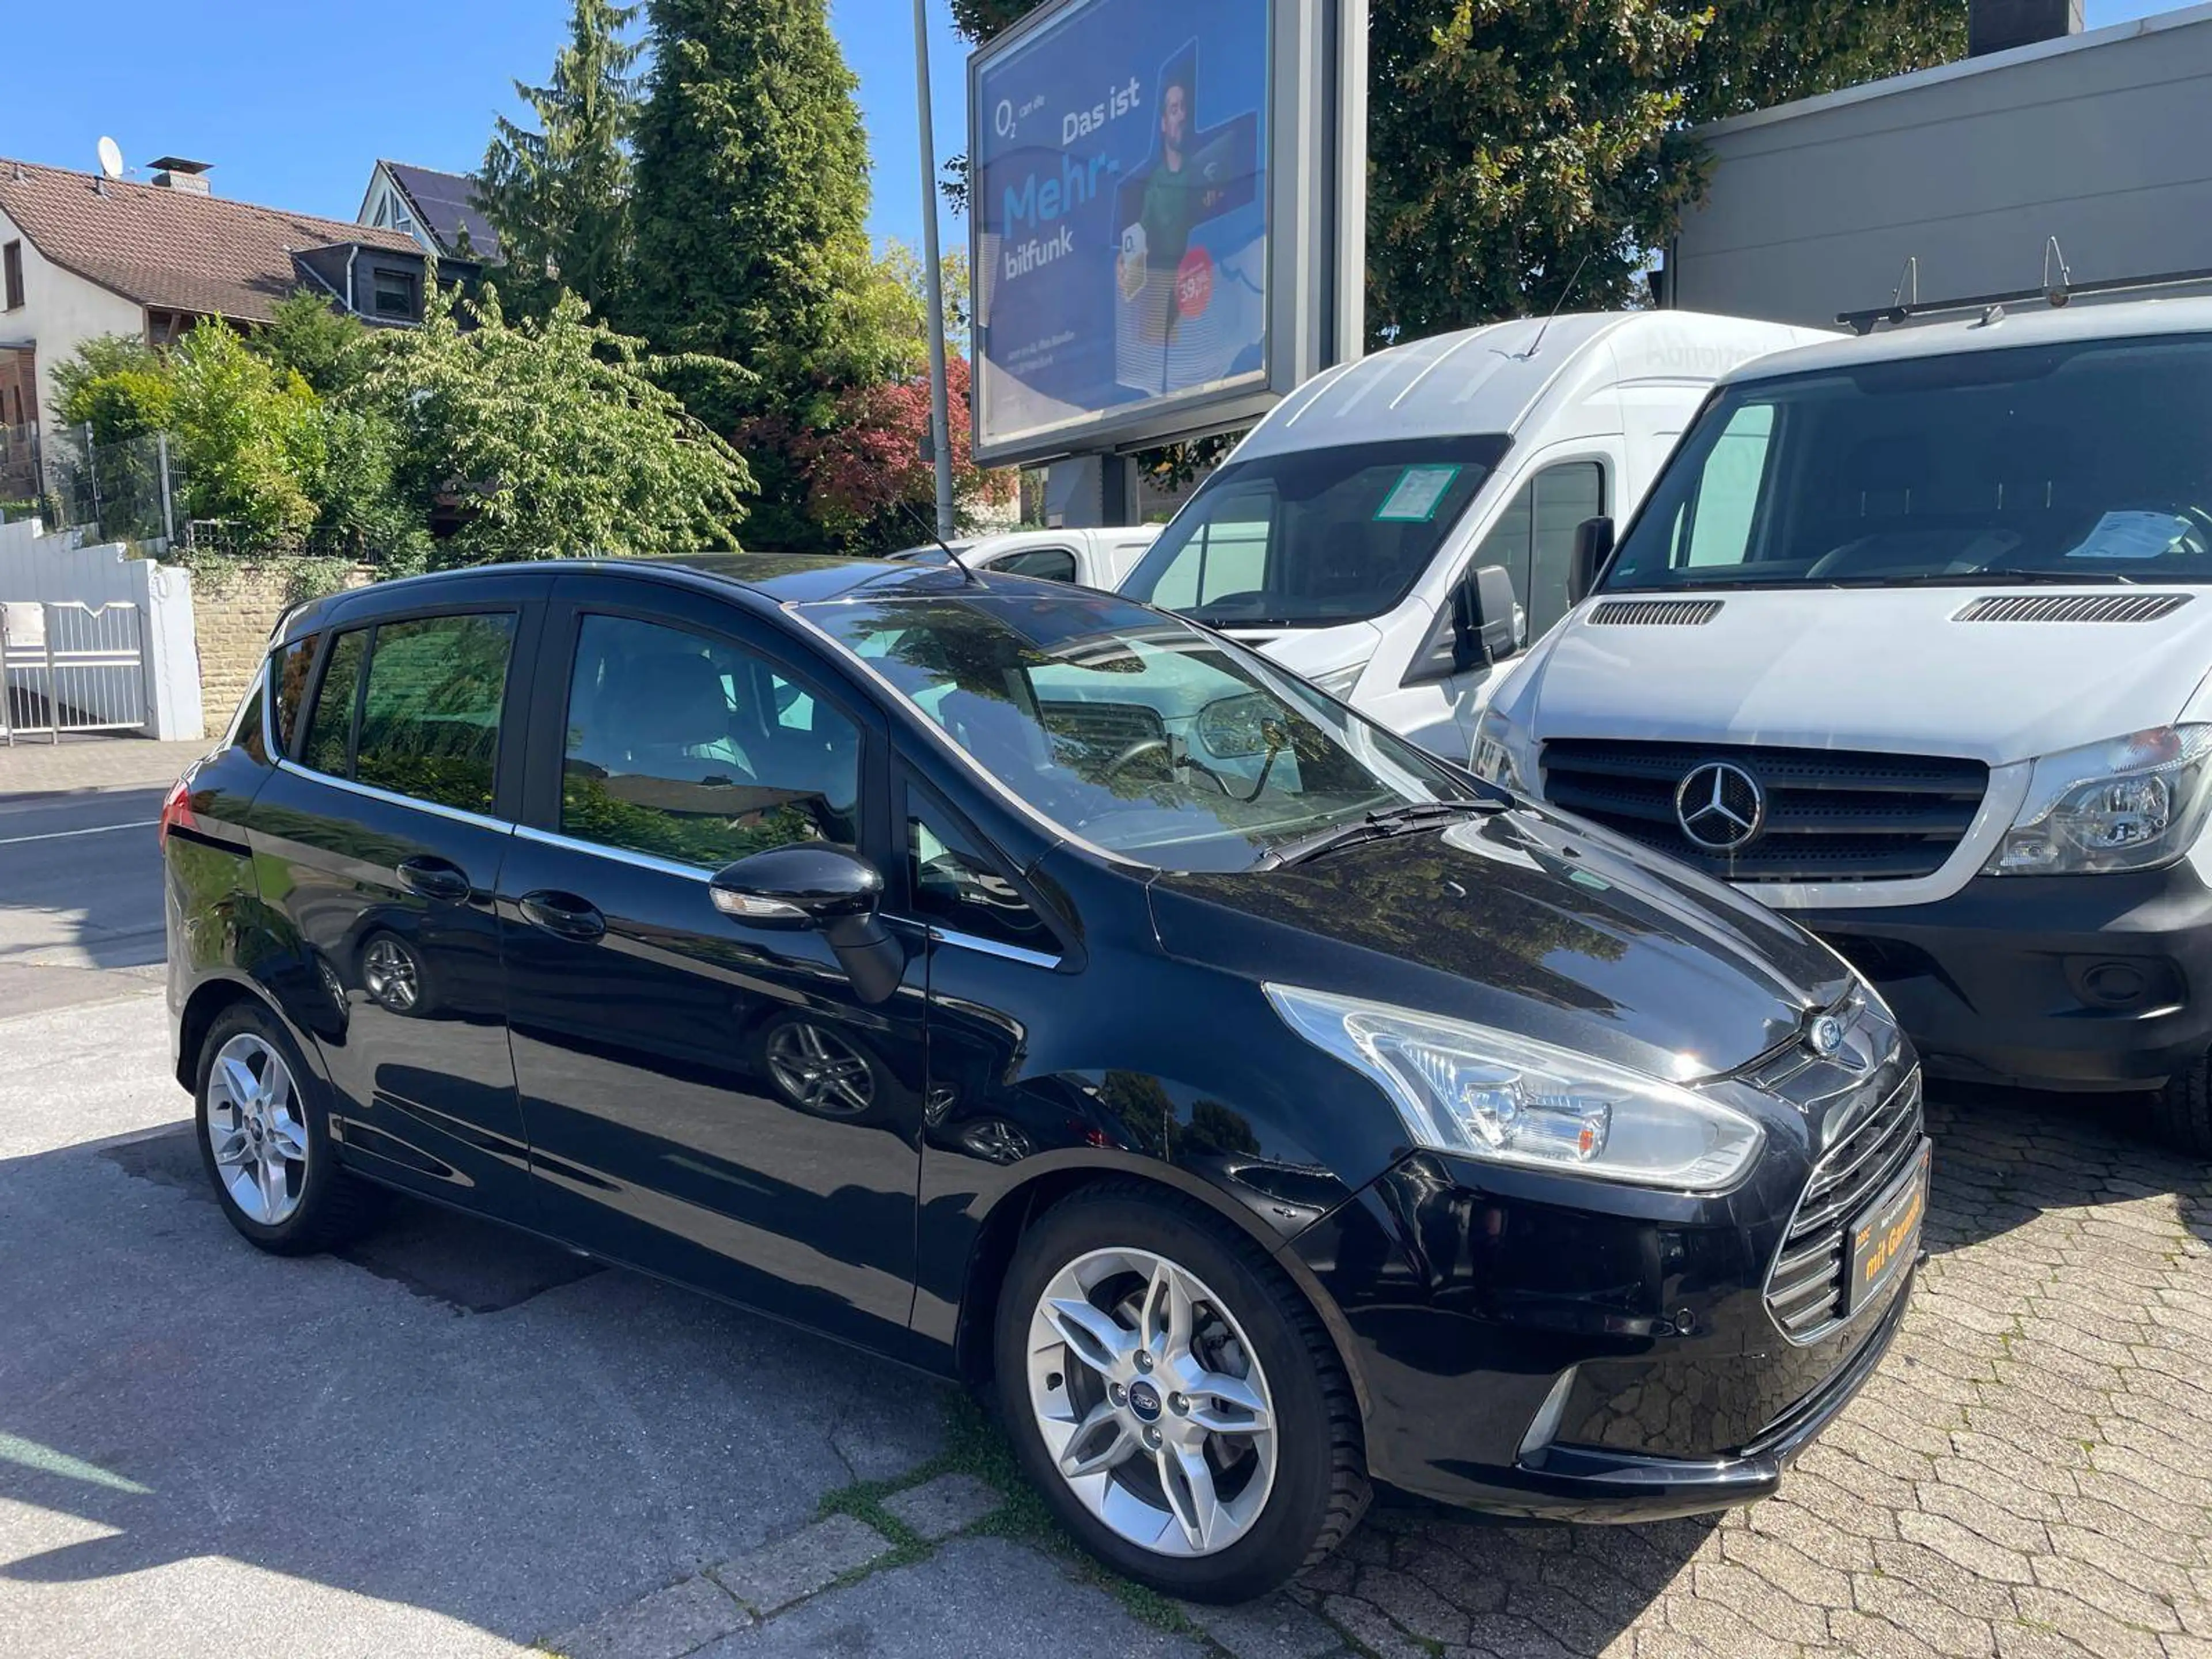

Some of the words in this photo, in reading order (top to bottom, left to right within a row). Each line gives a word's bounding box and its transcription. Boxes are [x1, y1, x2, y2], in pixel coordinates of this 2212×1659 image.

[1062, 112, 1105, 145] Das
[1110, 76, 1140, 120] ist
[1004, 225, 1074, 281] bilfunk
[1866, 1239, 1886, 1282] mit
